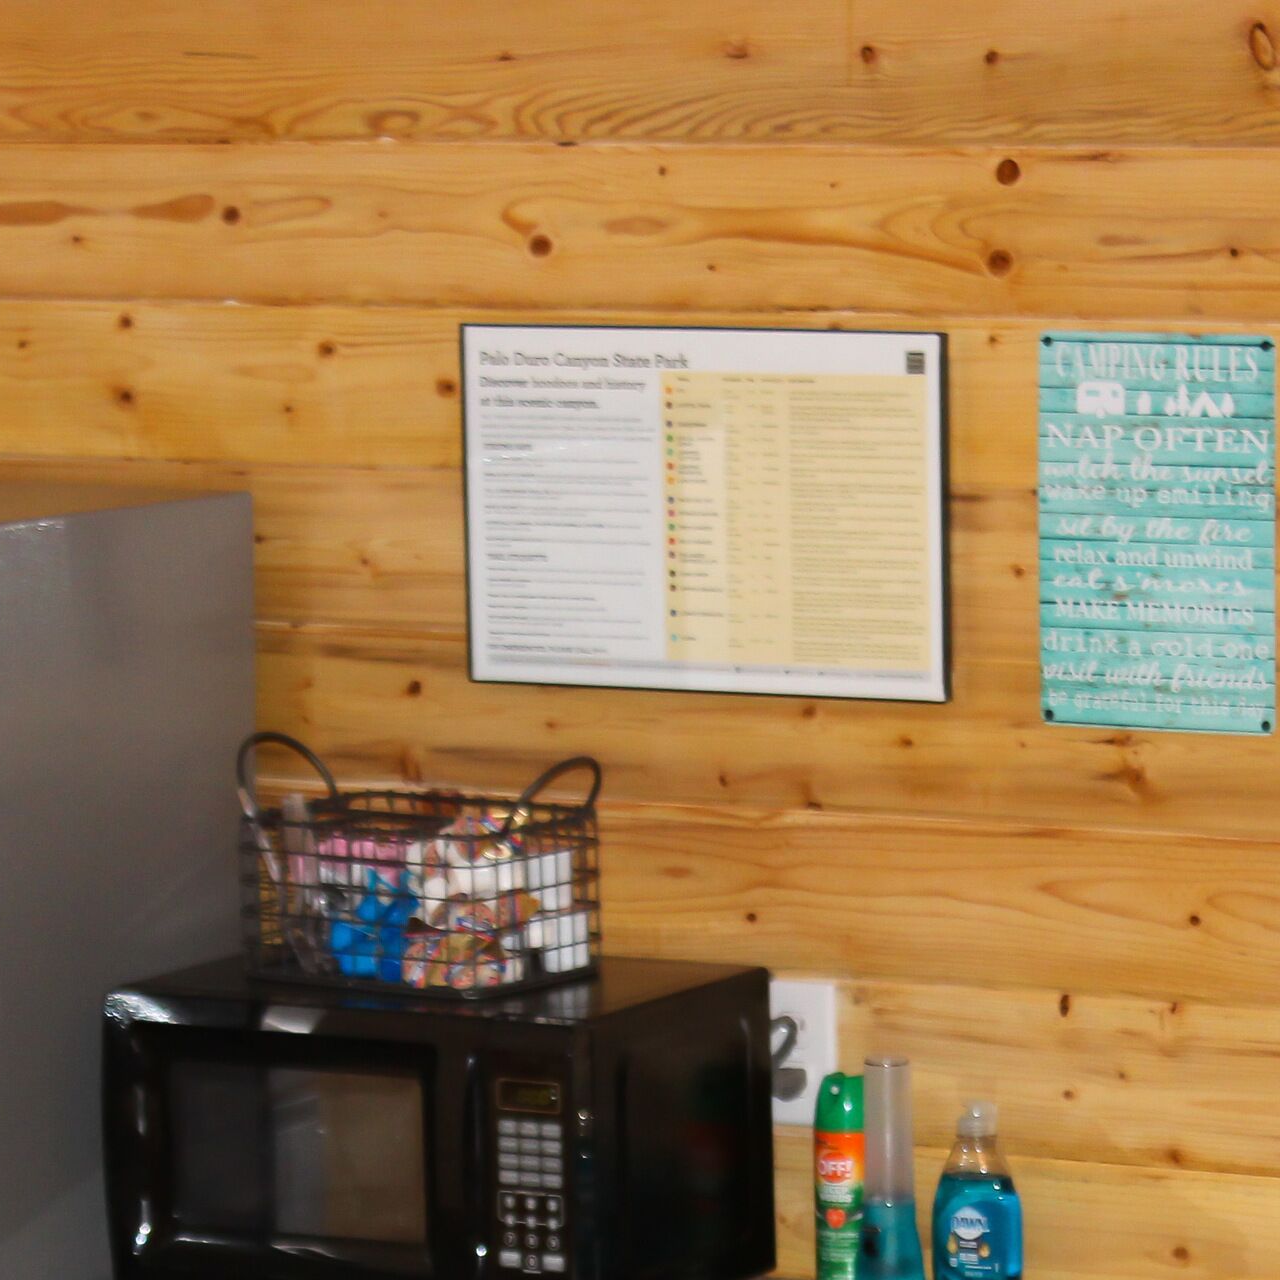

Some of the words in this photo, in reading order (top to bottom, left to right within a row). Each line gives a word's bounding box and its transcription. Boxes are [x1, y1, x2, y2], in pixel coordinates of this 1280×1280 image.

[479, 351, 510, 366] Palo
[514, 352, 549, 367] Duro
[553, 352, 610, 371] Canyon
[613, 353, 651, 368] State
[655, 353, 689, 369] Park
[1055, 343, 1167, 381] CAMPING
[1175, 345, 1260, 383] RULES
[1045, 422, 1125, 450] NAP
[1134, 426, 1270, 454] OFTEN
[1044, 452, 1120, 481] watch
[1130, 453, 1171, 482] the
[1182, 460, 1270, 486] sunset
[1044, 484, 1106, 501] wake
[1117, 486, 1148, 509] up
[1157, 484, 1270, 513] smiling
[1056, 516, 1093, 537] sit
[1100, 515, 1136, 545] by
[1145, 517, 1192, 540] the
[1199, 518, 1254, 546] fire
[1053, 543, 1109, 565] relax
[1116, 546, 1157, 567] and
[1164, 548, 1253, 571] unwind
[1052, 567, 1106, 591] eat
[1114, 572, 1250, 597] s'mores
[1054, 597, 1120, 621] MAKE
[1127, 600, 1254, 626] MEMORIES
[1044, 630, 1120, 654] drink
[1128, 641, 1142, 657] a
[1150, 636, 1213, 659] cold
[1222, 642, 1270, 661] one
[1043, 660, 1097, 683] visit
[1105, 661, 1163, 686] with
[1171, 662, 1270, 693] friends
